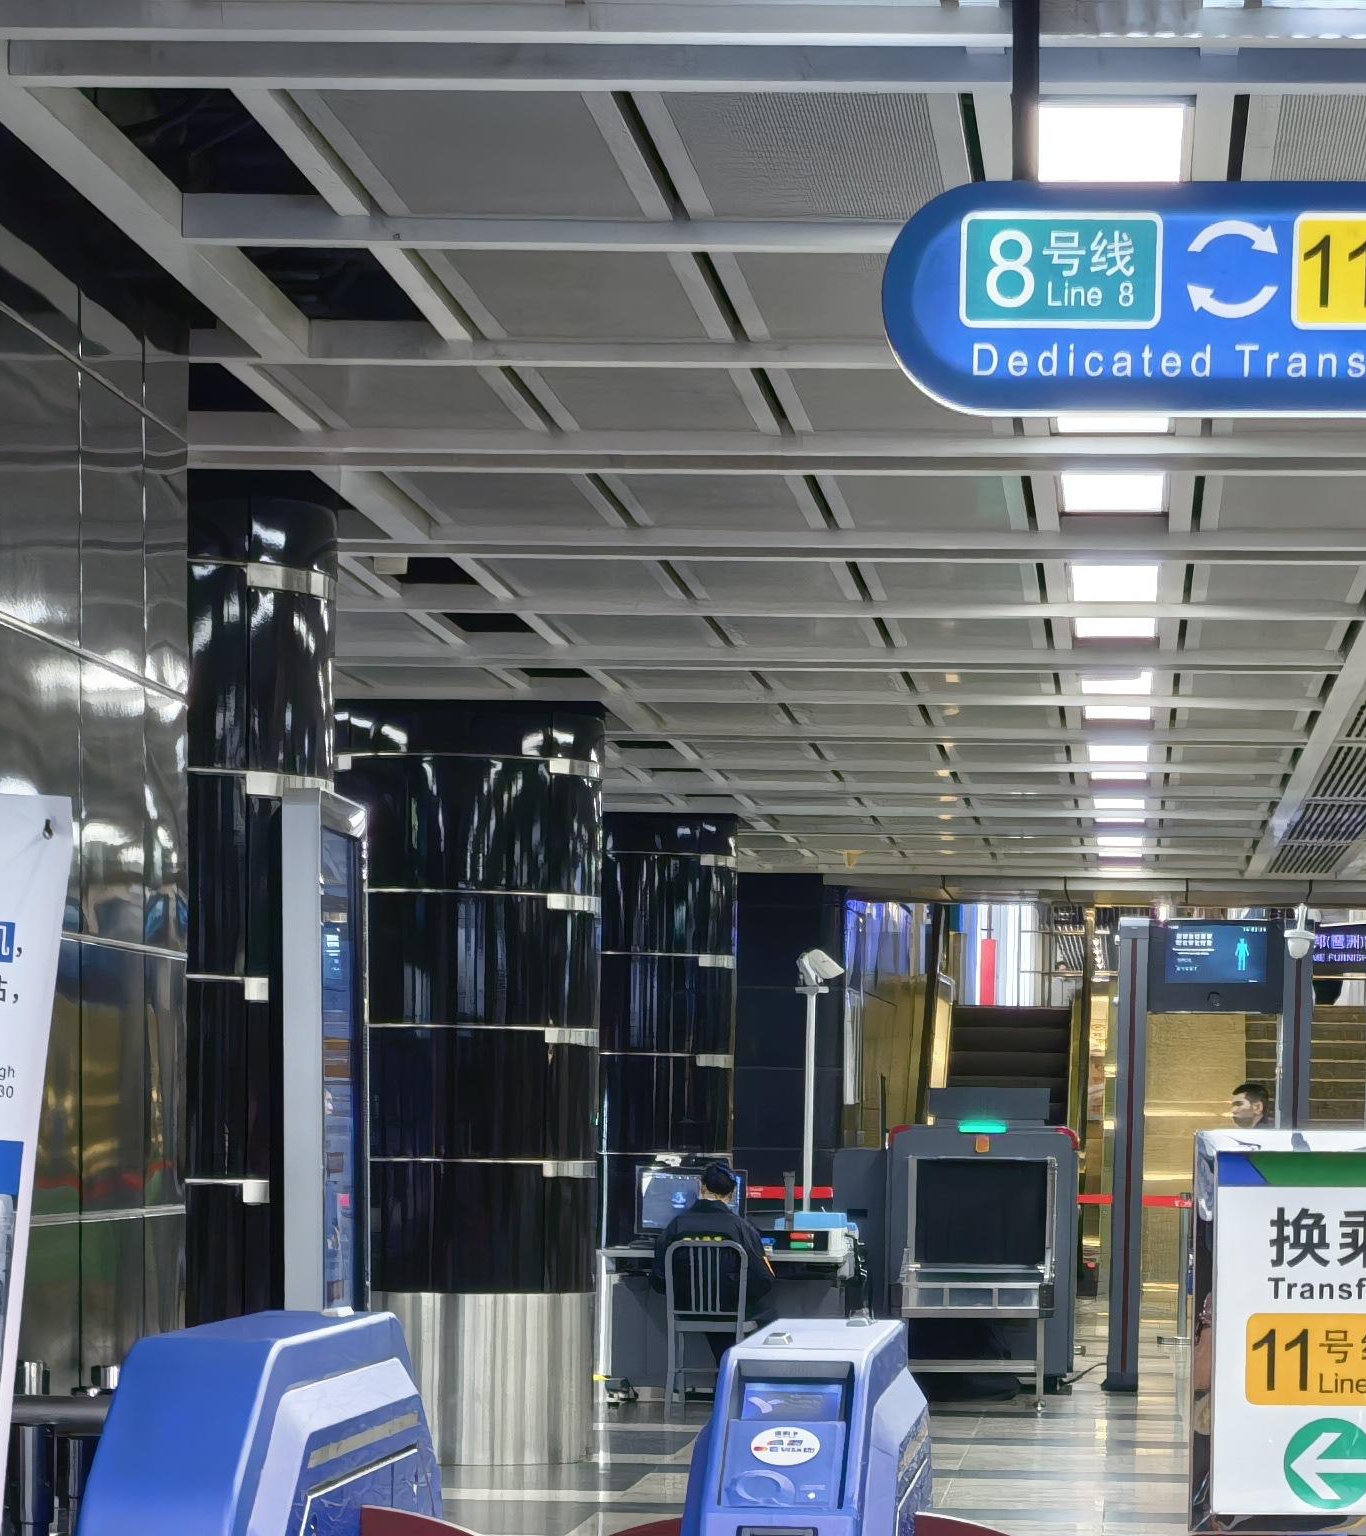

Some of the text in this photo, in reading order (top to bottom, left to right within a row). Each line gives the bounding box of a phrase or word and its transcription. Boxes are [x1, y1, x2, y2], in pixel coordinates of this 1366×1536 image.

[985, 229, 1036, 309] 8
[1042, 229, 1136, 278] 号线
[1047, 280, 1135, 308] Line 8
[971, 341, 1213, 378] Dedicated
[1251, 1328, 1310, 1393] 11
